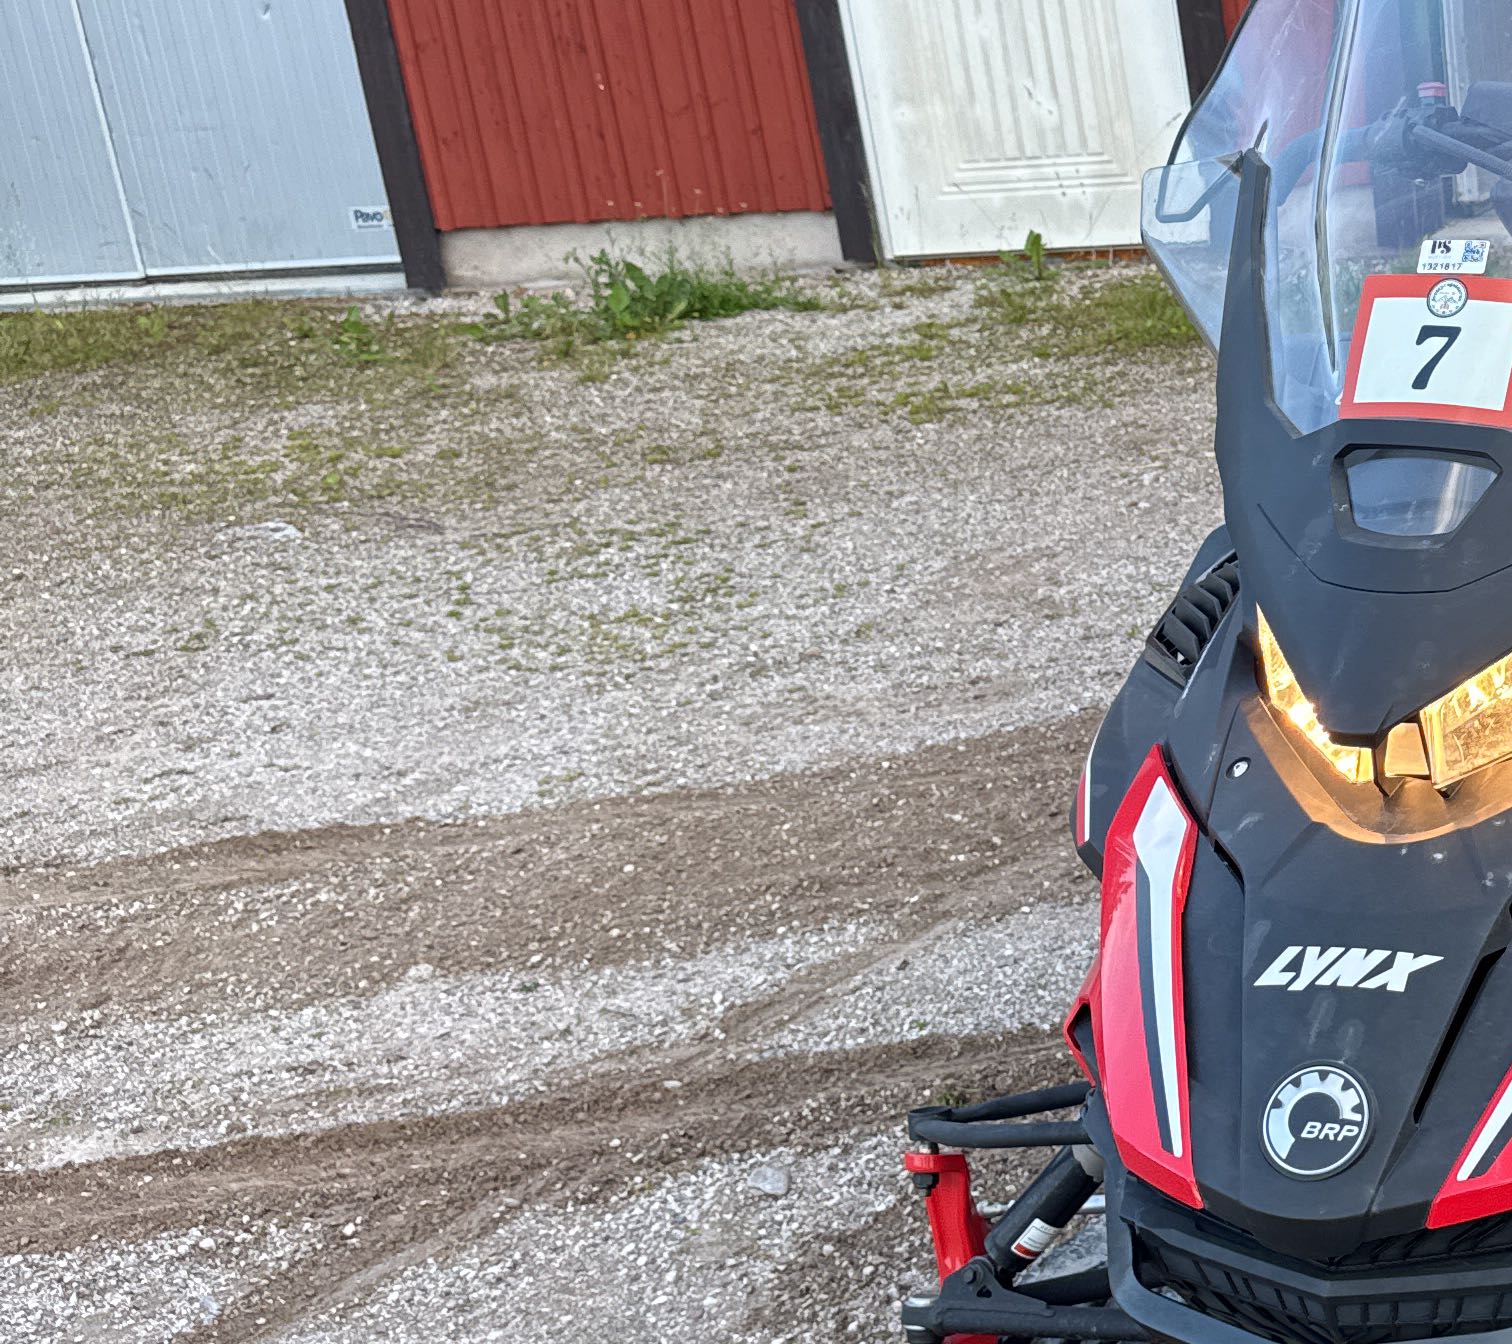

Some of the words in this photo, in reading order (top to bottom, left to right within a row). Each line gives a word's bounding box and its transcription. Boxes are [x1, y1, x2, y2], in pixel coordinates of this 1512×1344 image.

[1410, 325, 1462, 390] 7
[1253, 945, 1445, 993] LYNX
[1301, 1121, 1360, 1142] BRP
